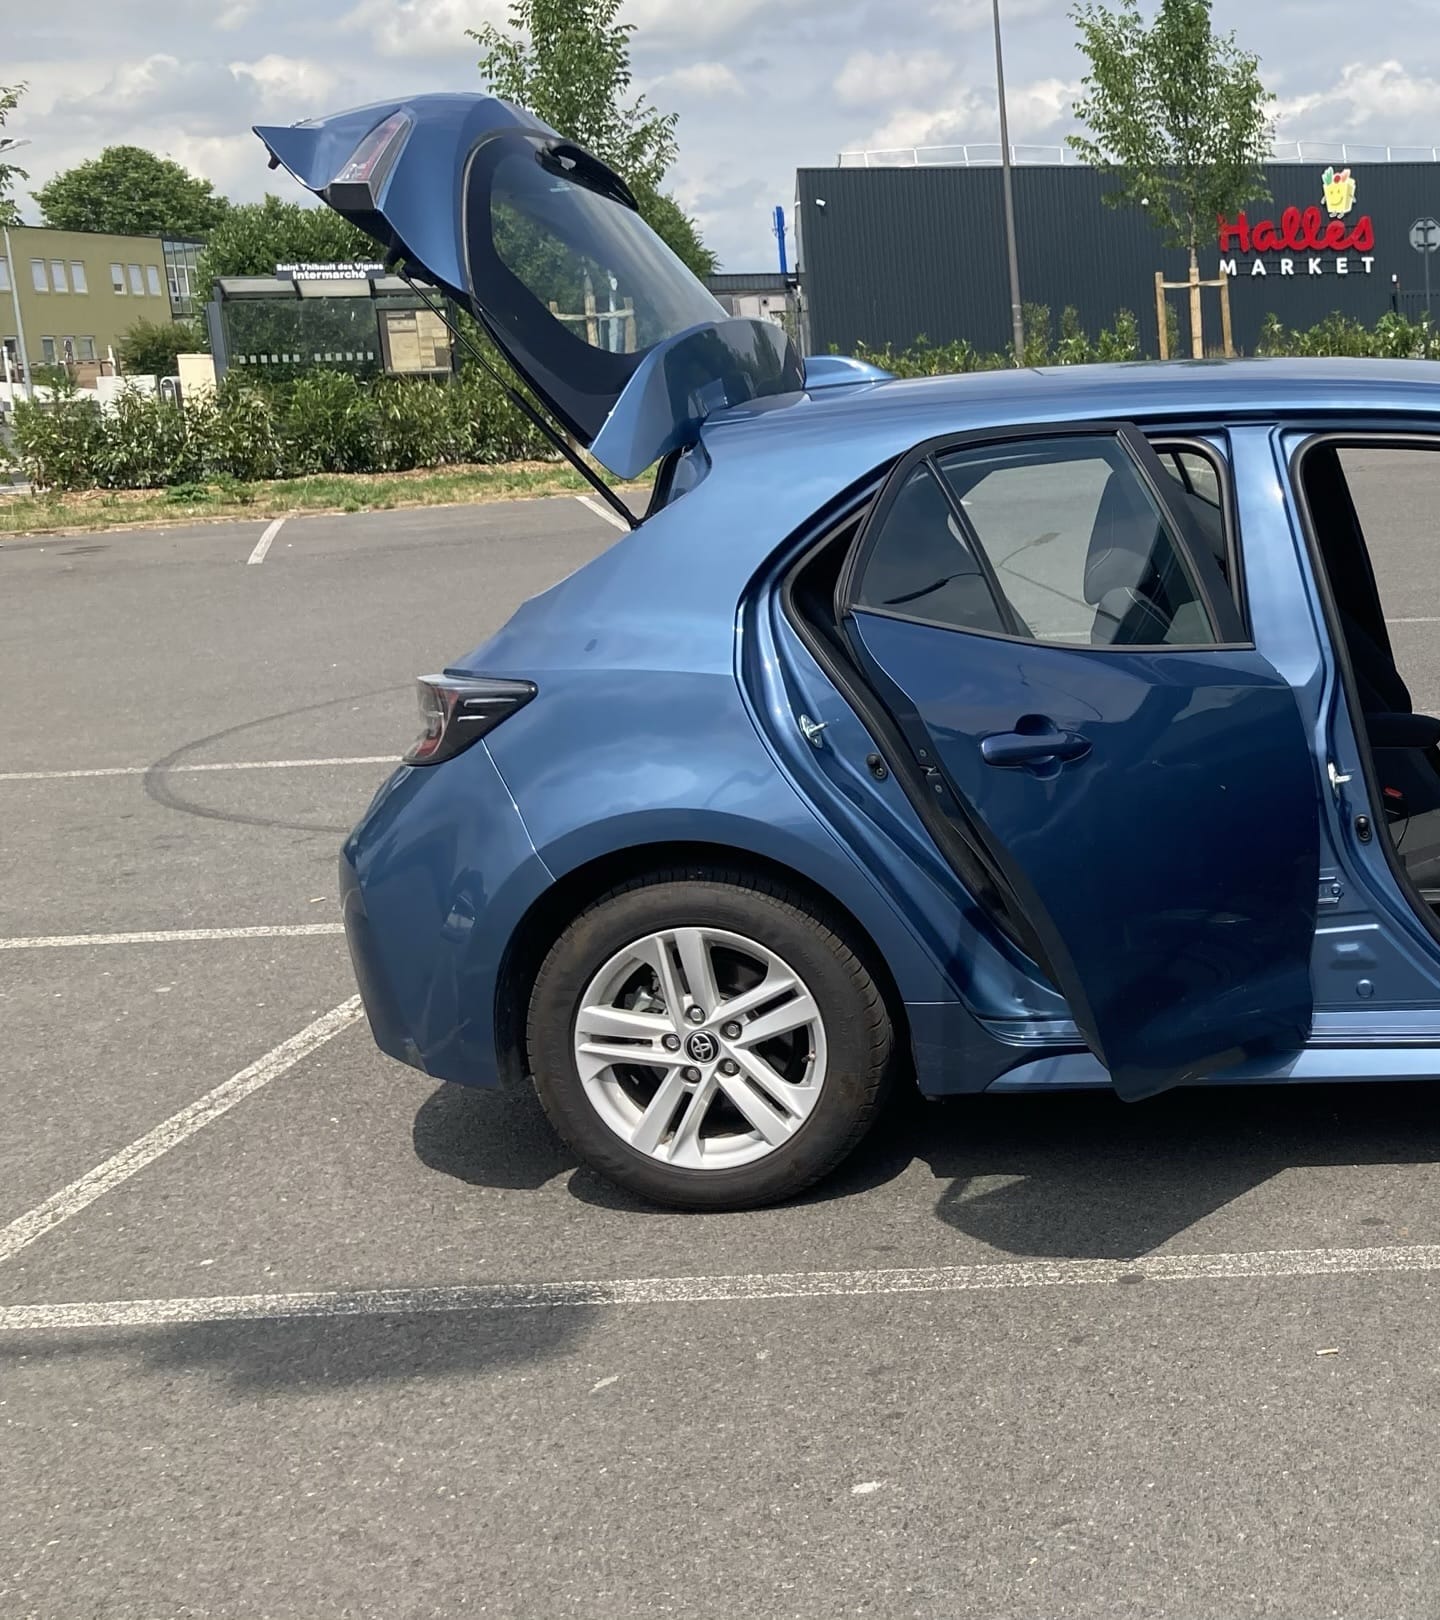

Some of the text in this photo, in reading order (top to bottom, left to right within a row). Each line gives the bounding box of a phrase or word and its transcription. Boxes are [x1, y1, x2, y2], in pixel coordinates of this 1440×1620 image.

[1217, 206, 1375, 252] Halles
[354, 262, 384, 271] Vignes
[1219, 256, 1375, 276] MARKET
[292, 270, 367, 280] Intermarché
